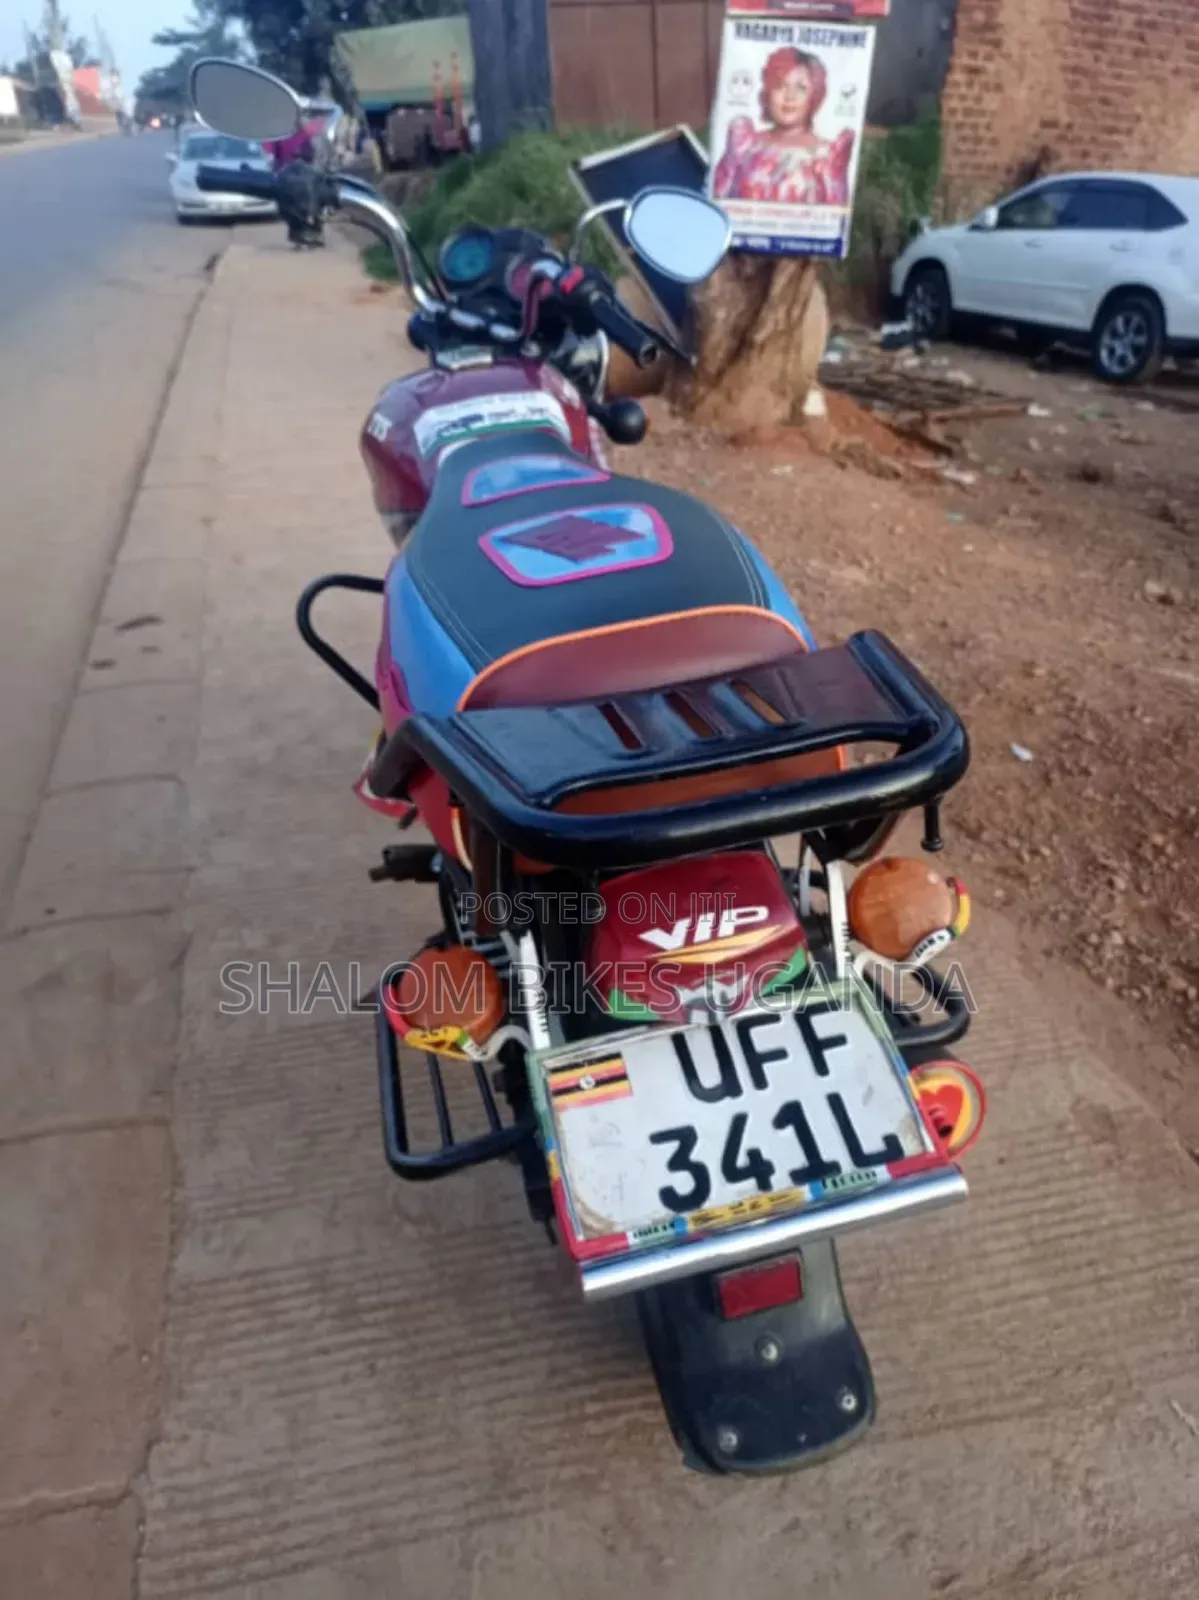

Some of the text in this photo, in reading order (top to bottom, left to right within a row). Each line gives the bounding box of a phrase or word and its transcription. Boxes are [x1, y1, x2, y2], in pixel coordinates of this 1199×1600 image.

[638, 905, 769, 950] VIP
[671, 1001, 848, 1103] UFF
[649, 1092, 904, 1212] 341L
